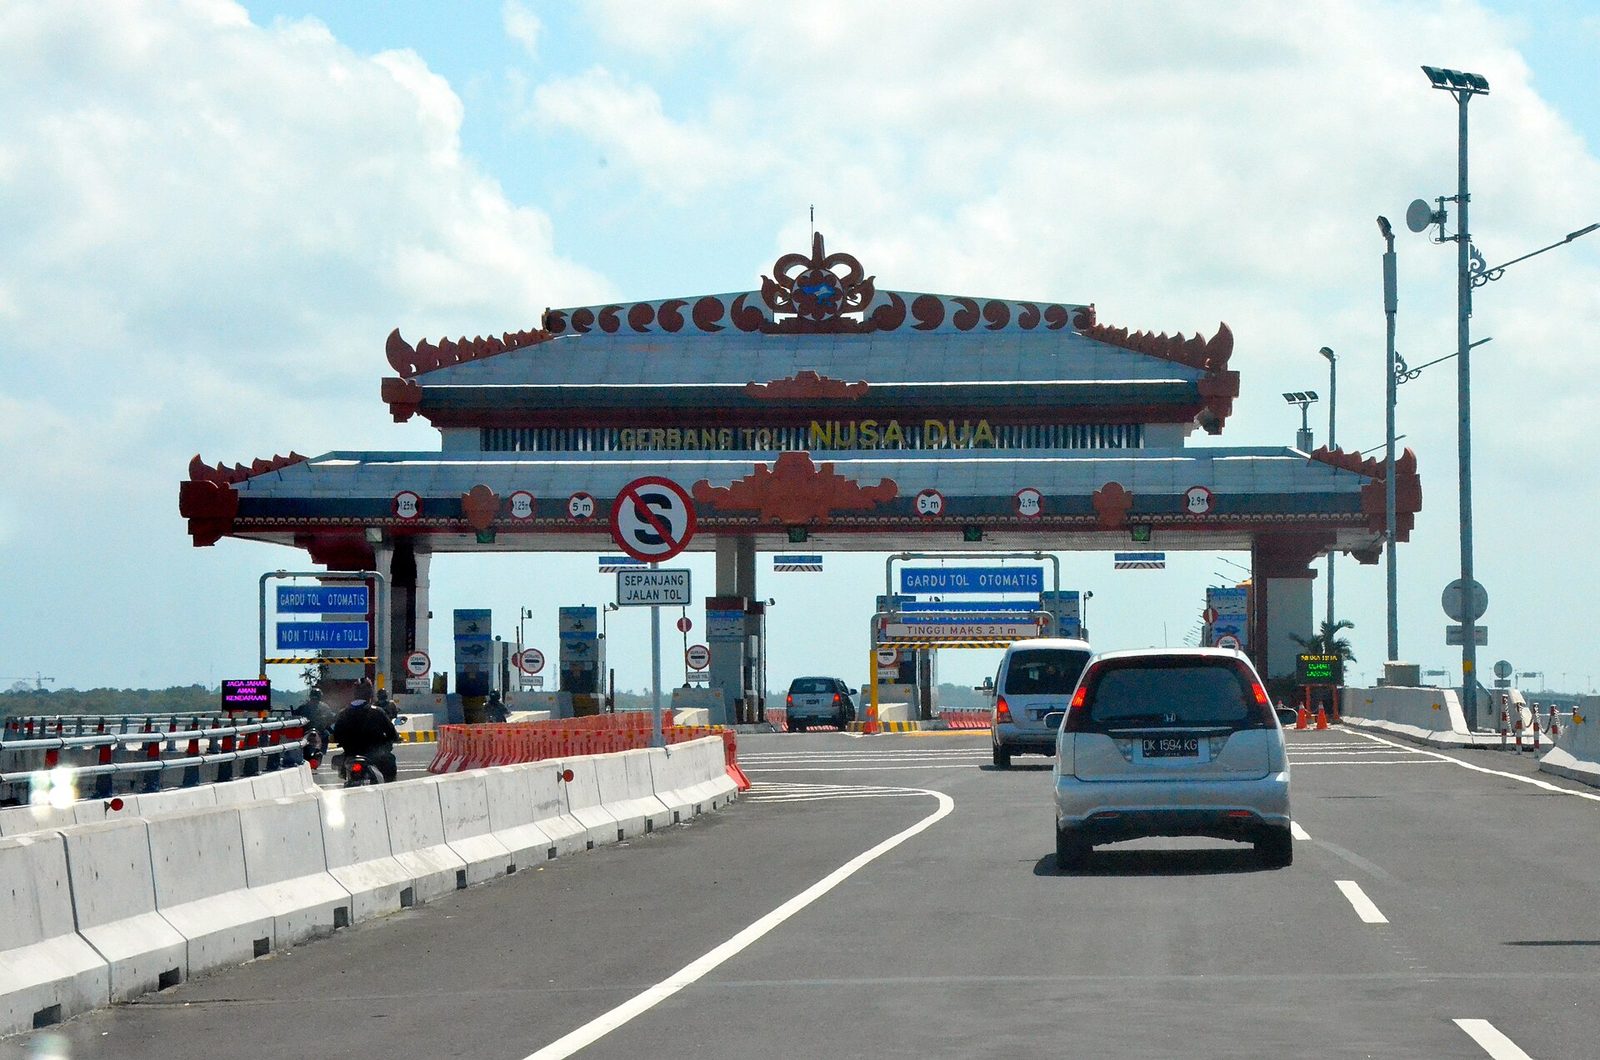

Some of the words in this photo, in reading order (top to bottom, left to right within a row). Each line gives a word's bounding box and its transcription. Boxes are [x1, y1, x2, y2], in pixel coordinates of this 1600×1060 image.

[619, 428, 734, 450] GERBANG
[742, 428, 786, 450] TOL
[809, 419, 906, 447] NUSA
[924, 419, 996, 447] DUA
[572, 502, 579, 512] 5
[920, 499, 927, 509] 5
[930, 501, 939, 509] m
[634, 493, 672, 545] S
[624, 575, 684, 586] SEPANJANG
[906, 575, 946, 586] GARDU
[949, 574, 970, 586] TOL
[979, 574, 1038, 586] OTOMATIS
[280, 594, 305, 606] GARDU
[307, 594, 321, 606] TOL
[327, 594, 365, 606] OTOMATIS
[626, 589, 660, 600] JALAN
[663, 589, 682, 600] TOL
[281, 630, 299, 642] NON
[343, 629, 364, 641] TOLL
[906, 625, 945, 635] TINGGI
[1143, 739, 1156, 751] DK
[1159, 739, 1182, 751] 1594
[1184, 739, 1198, 751] KG
